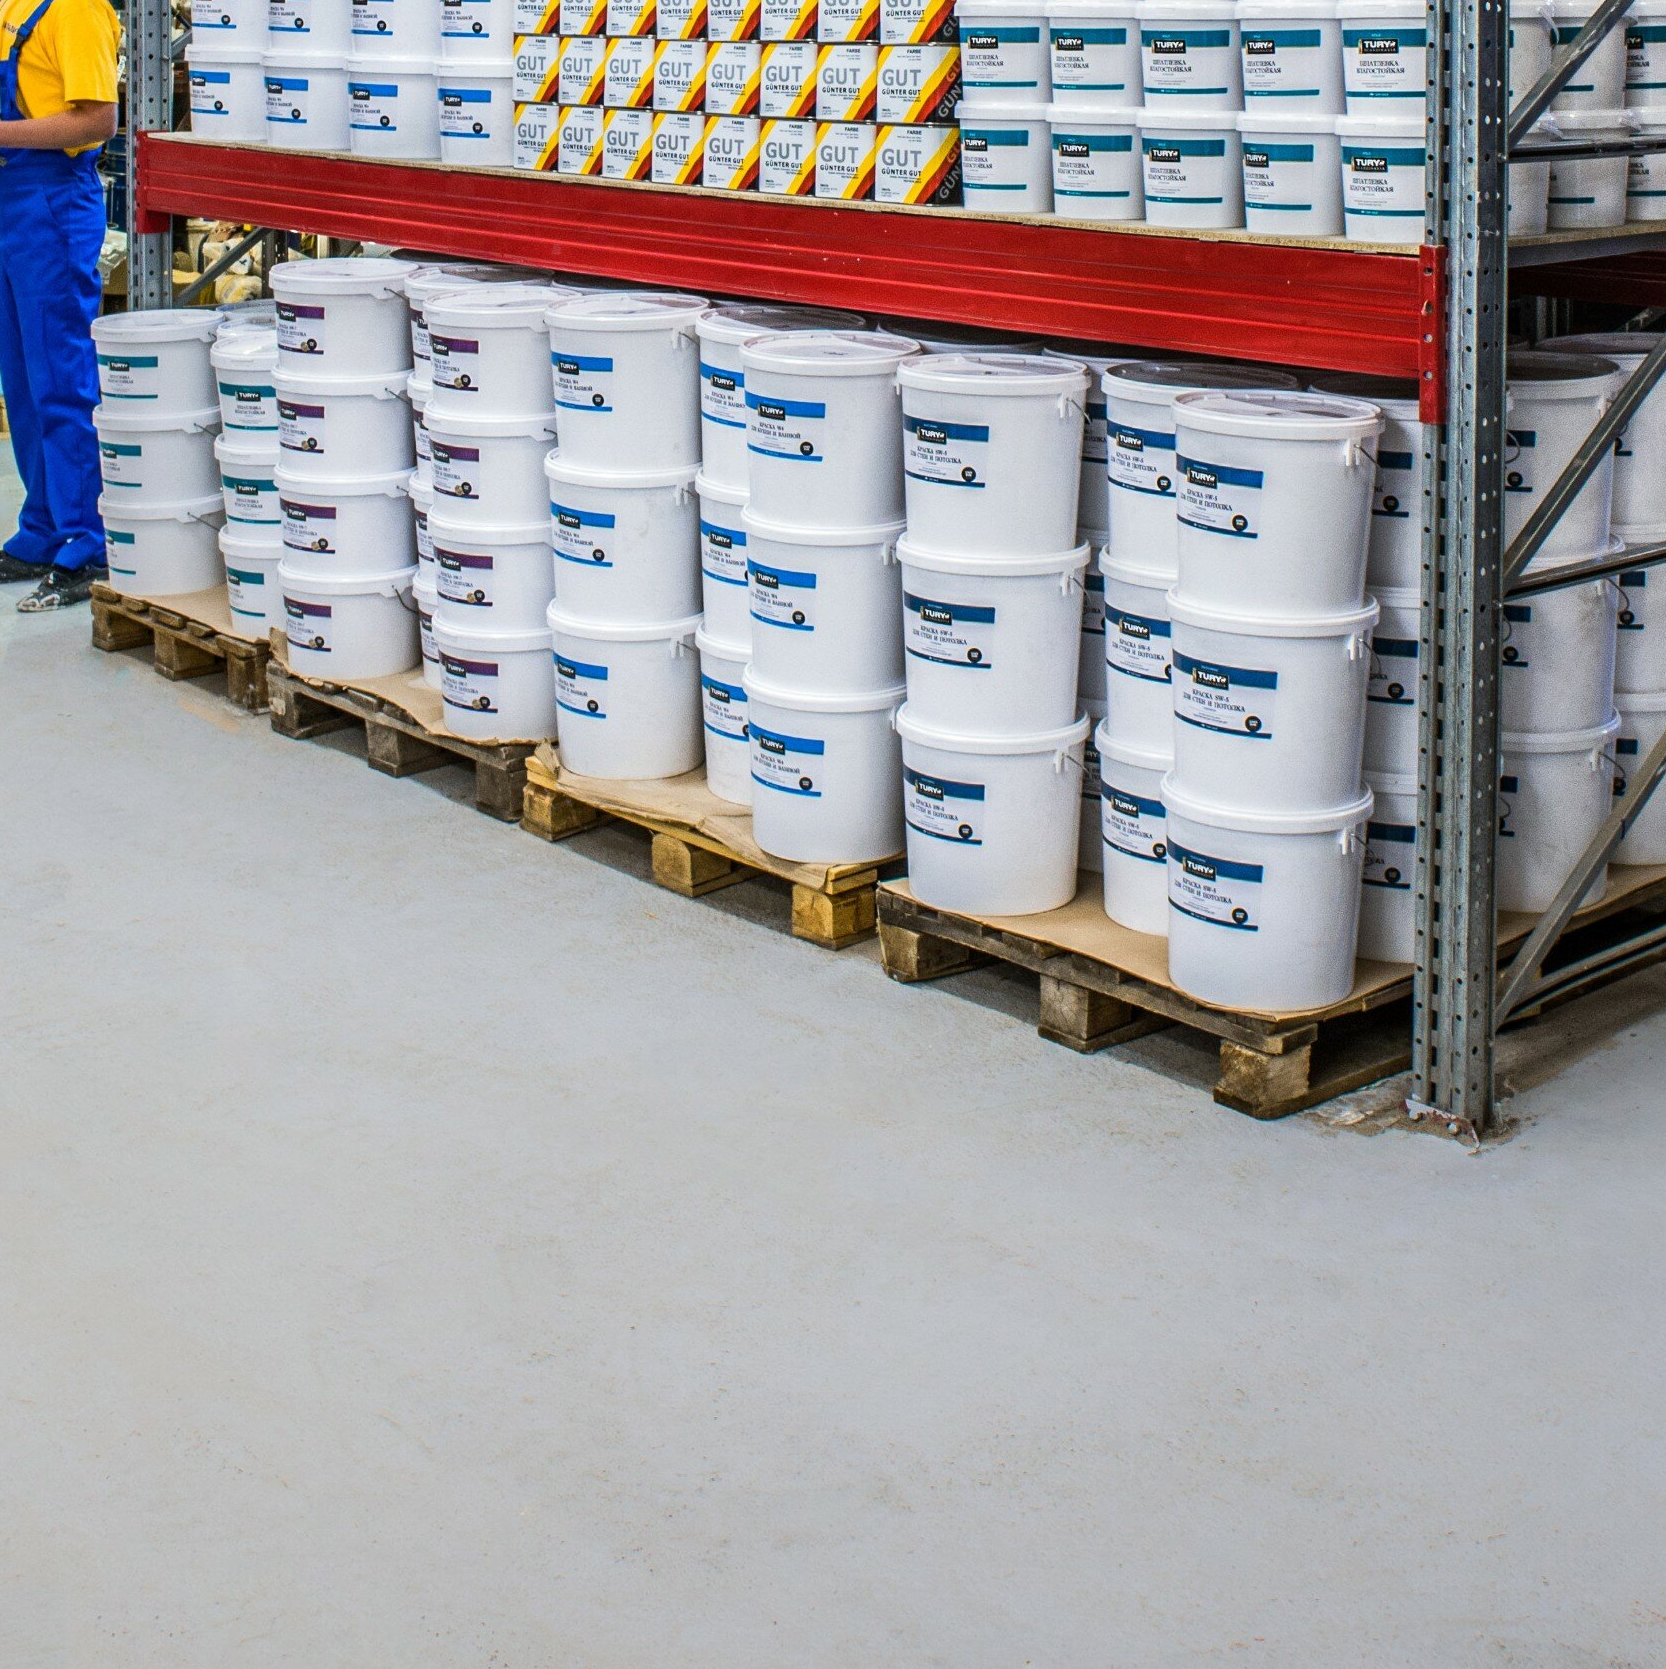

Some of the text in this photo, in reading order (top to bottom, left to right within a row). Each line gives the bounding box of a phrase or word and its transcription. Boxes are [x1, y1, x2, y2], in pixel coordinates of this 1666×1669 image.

[883, 70, 921, 86] GUT
[882, 88, 907, 96] GÜNTER
[766, 143, 802, 159] GUT
[883, 149, 921, 167] GUT
[761, 406, 779, 414] TURY
[921, 429, 940, 438] TURY
[1120, 435, 1137, 444] TURY
[1191, 471, 1210, 481] TURY
[925, 609, 945, 618] TURY
[1198, 672, 1220, 682] TURY
[1187, 861, 1208, 873] TURY
